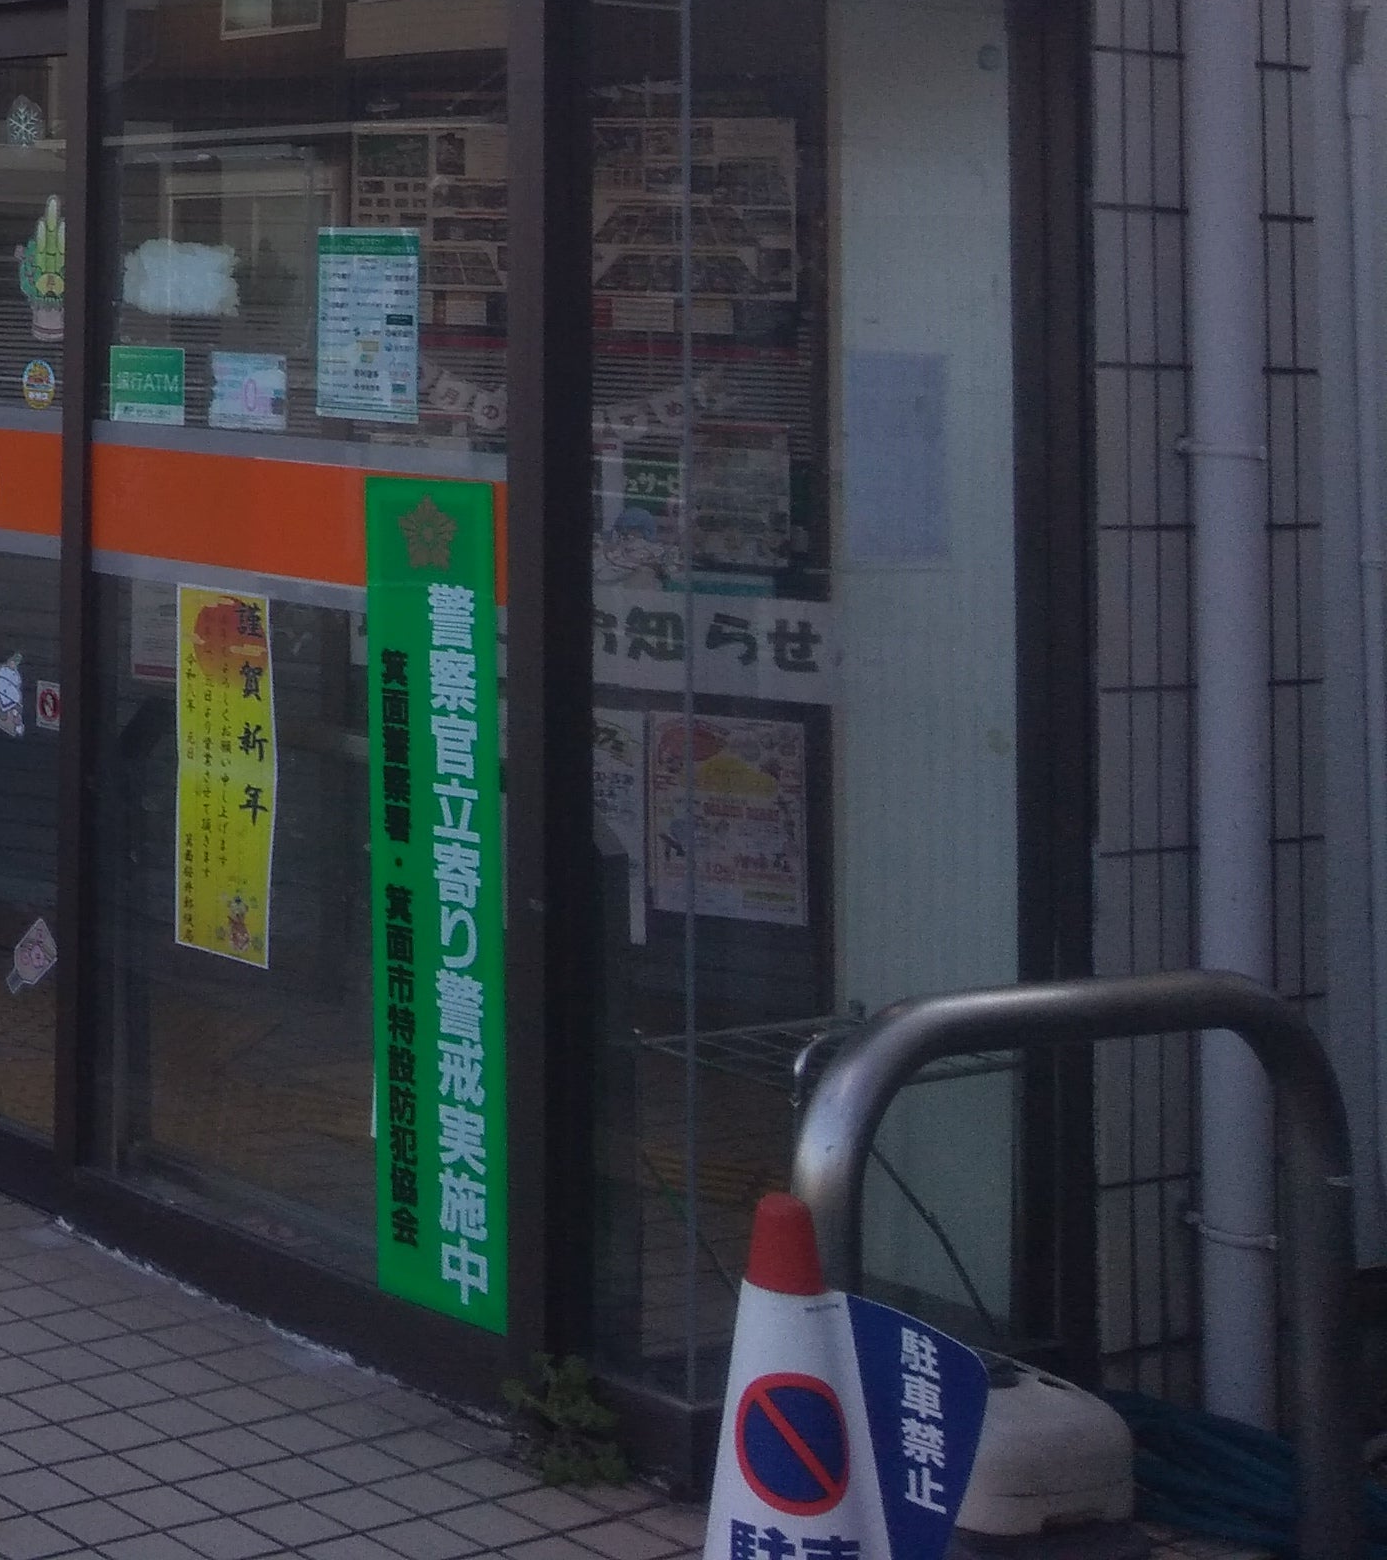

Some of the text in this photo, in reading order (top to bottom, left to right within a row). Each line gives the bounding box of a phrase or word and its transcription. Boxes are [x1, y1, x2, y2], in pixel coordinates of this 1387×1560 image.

[234, 600, 269, 827] 謹賀新年
[427, 582, 489, 1306] 警察官立寄り警戒実施中
[899, 1327, 948, 1515] 駐車禁止
